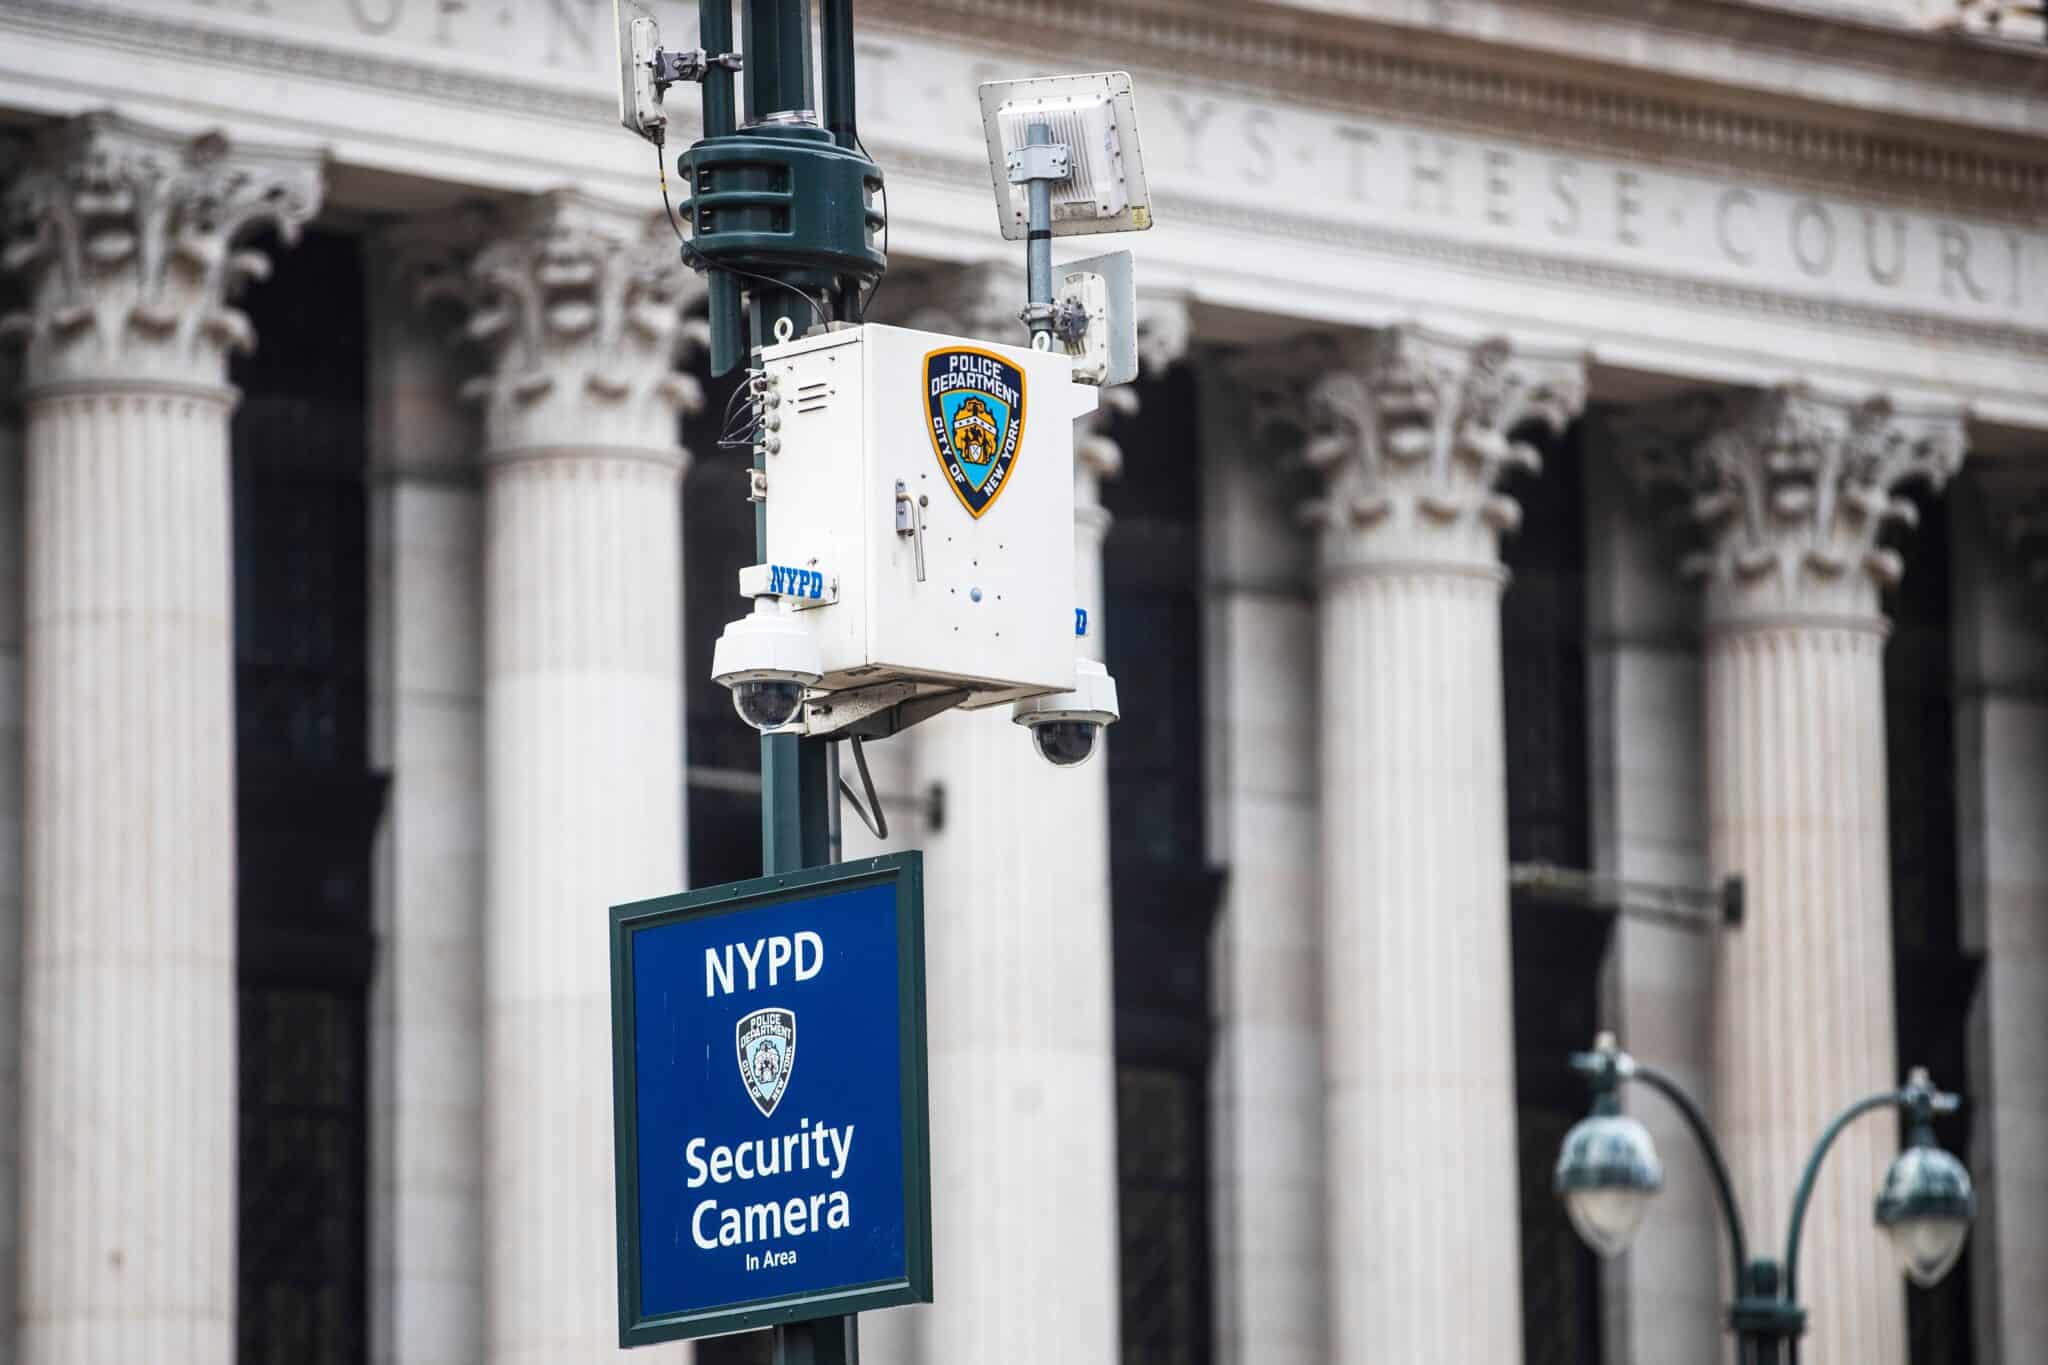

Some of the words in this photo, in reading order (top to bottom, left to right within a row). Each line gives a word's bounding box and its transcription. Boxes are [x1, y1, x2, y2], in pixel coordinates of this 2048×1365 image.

[1335, 125, 1645, 247] THESE
[931, 373, 1019, 408] DEPARTMENT
[950, 355, 1003, 380] POLICE
[933, 416, 952, 456] CITY
[950, 463, 966, 484] OF
[983, 463, 1005, 496] NEW
[1002, 418, 1020, 459] YORK
[770, 564, 823, 599] NYPD
[705, 931, 824, 998] NYPD
[741, 1024, 792, 1048] DEPARTMENT
[750, 1013, 782, 1027] POLICE
[685, 1118, 855, 1188] Security
[691, 1190, 850, 1249] Camera
[745, 1252, 759, 1271] In
[763, 1248, 797, 1269] Area
